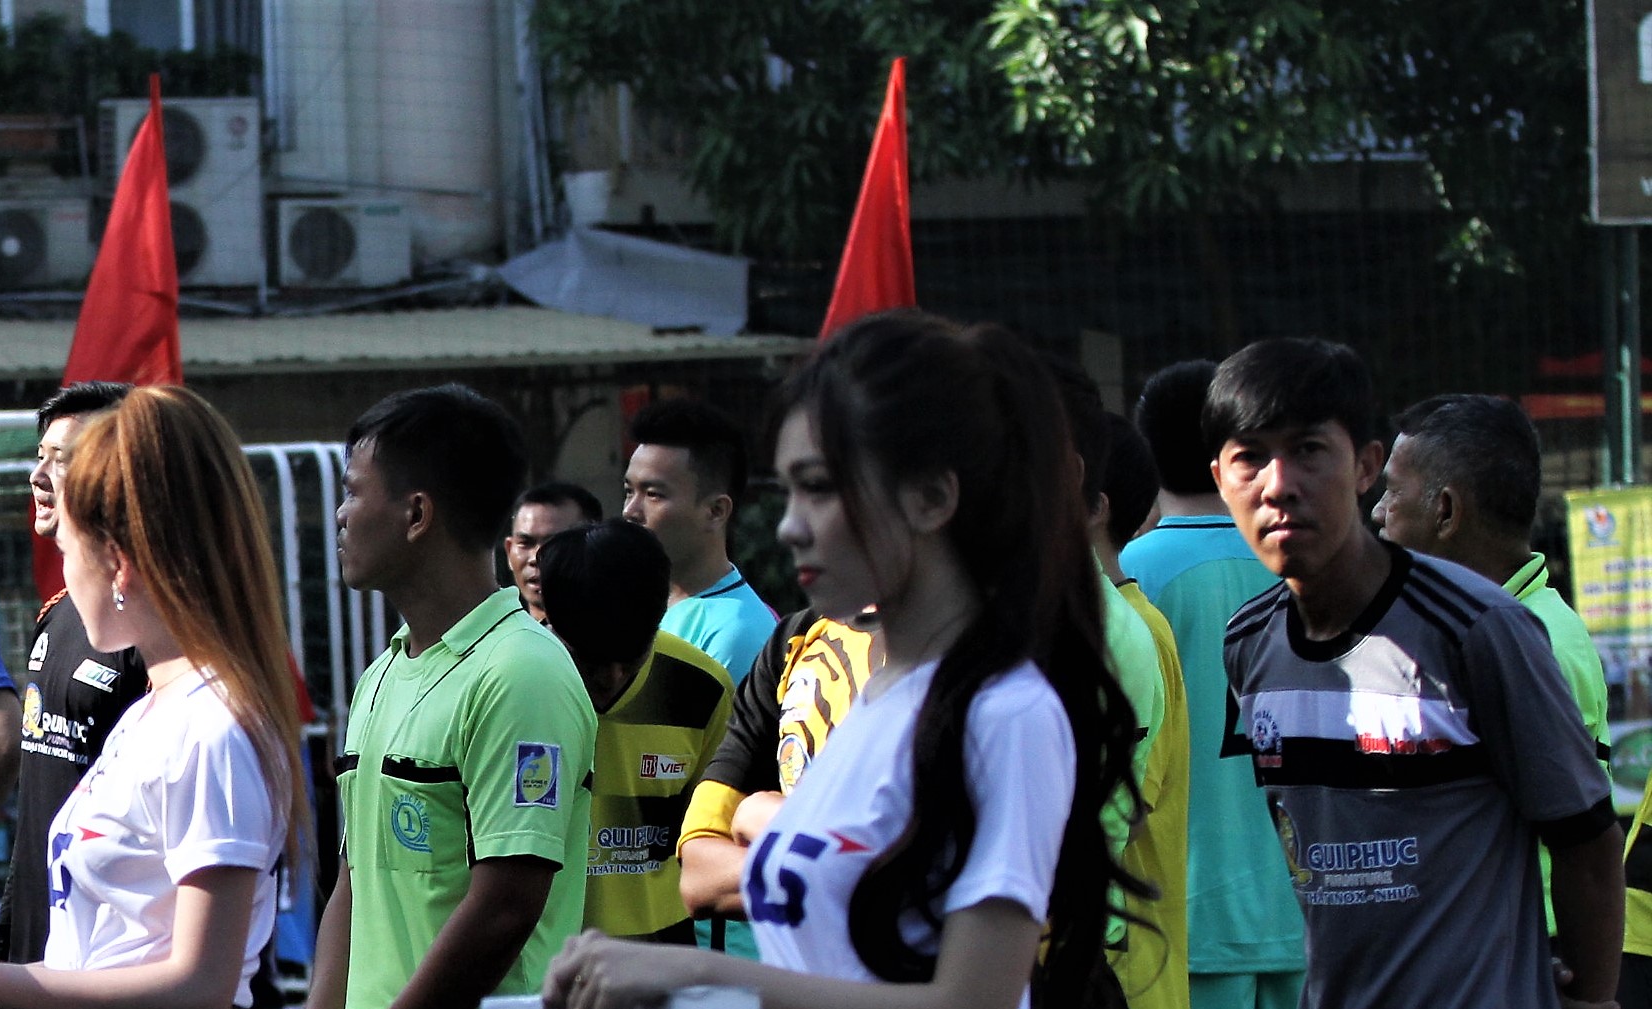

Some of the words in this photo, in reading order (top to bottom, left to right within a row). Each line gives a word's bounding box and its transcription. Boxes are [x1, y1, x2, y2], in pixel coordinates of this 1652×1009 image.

[661, 762, 686, 773] VIET
[1308, 843, 1344, 871] QUI
[1347, 837, 1419, 869] PHUC
[616, 863, 646, 875] INOX
